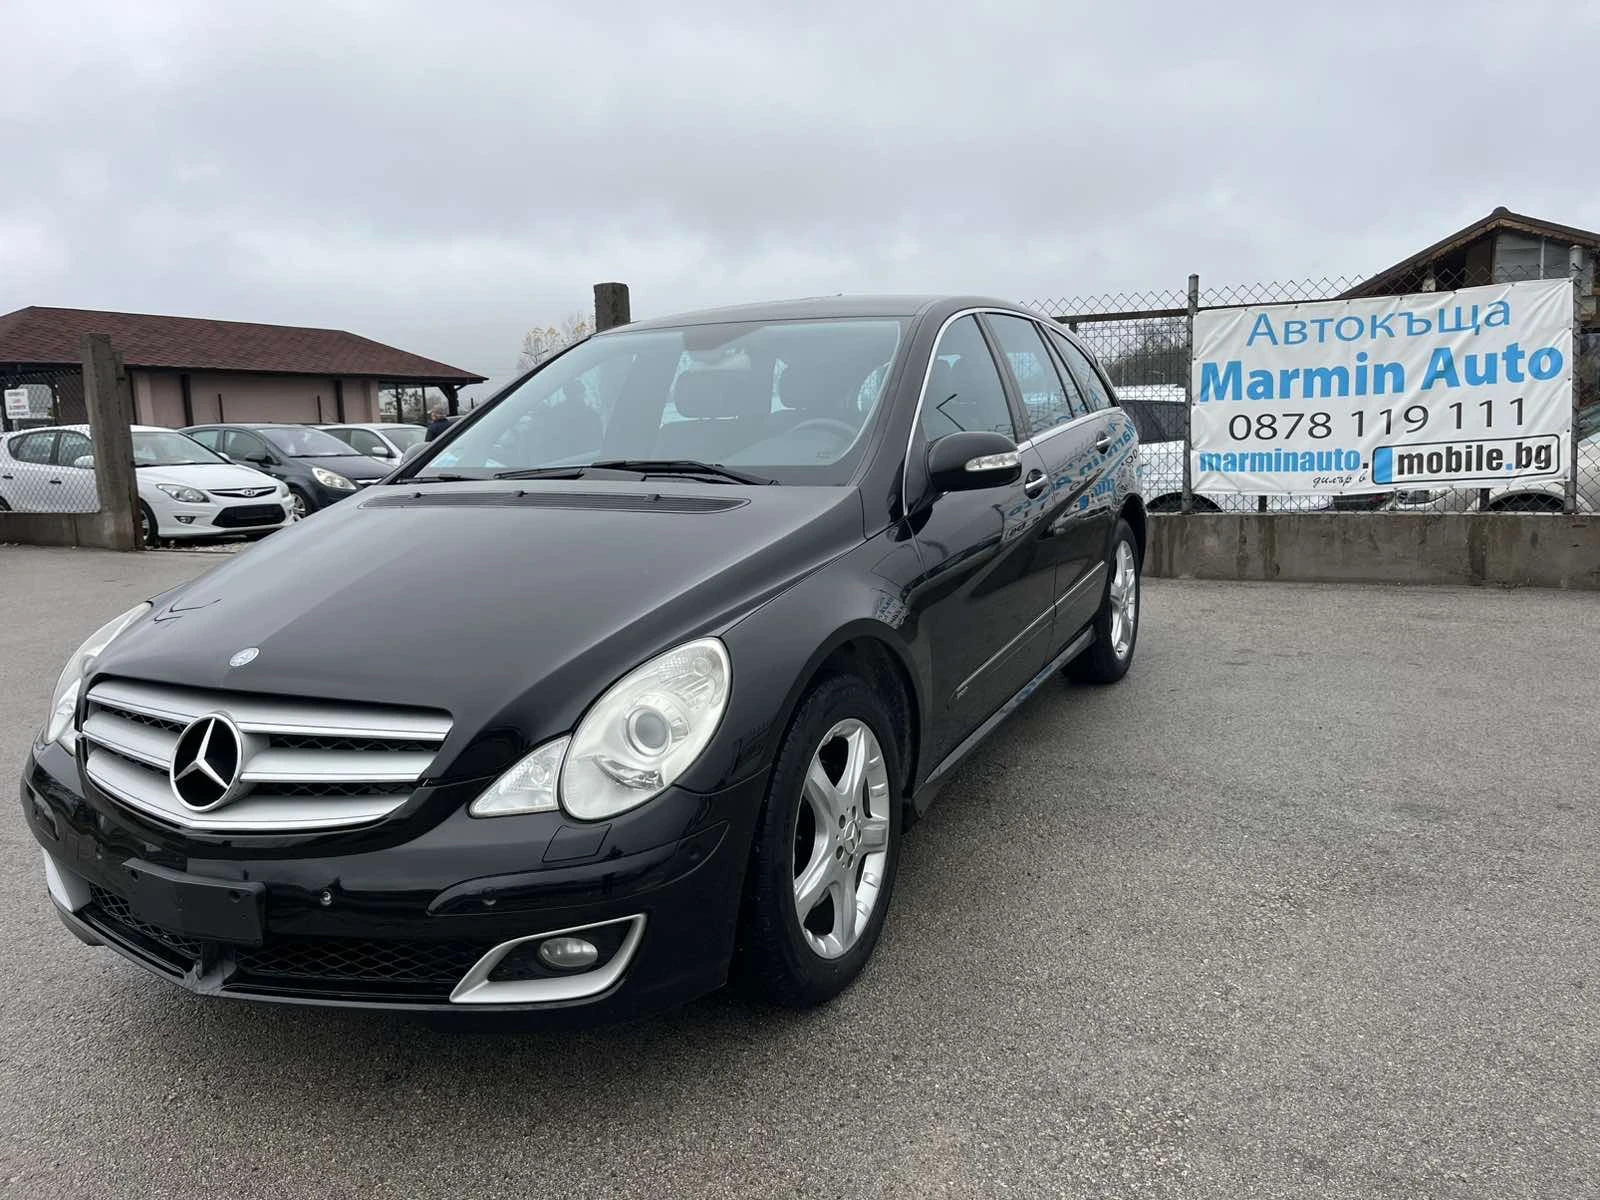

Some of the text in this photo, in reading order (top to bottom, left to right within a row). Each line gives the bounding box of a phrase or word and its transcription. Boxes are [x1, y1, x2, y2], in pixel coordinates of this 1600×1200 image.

[1246, 300, 1511, 346] Автокъща
[1200, 342, 1563, 402] Marmin Auto
[1229, 397, 1523, 440] 0878 119 111
[1397, 442, 1552, 475] mobile.bg
